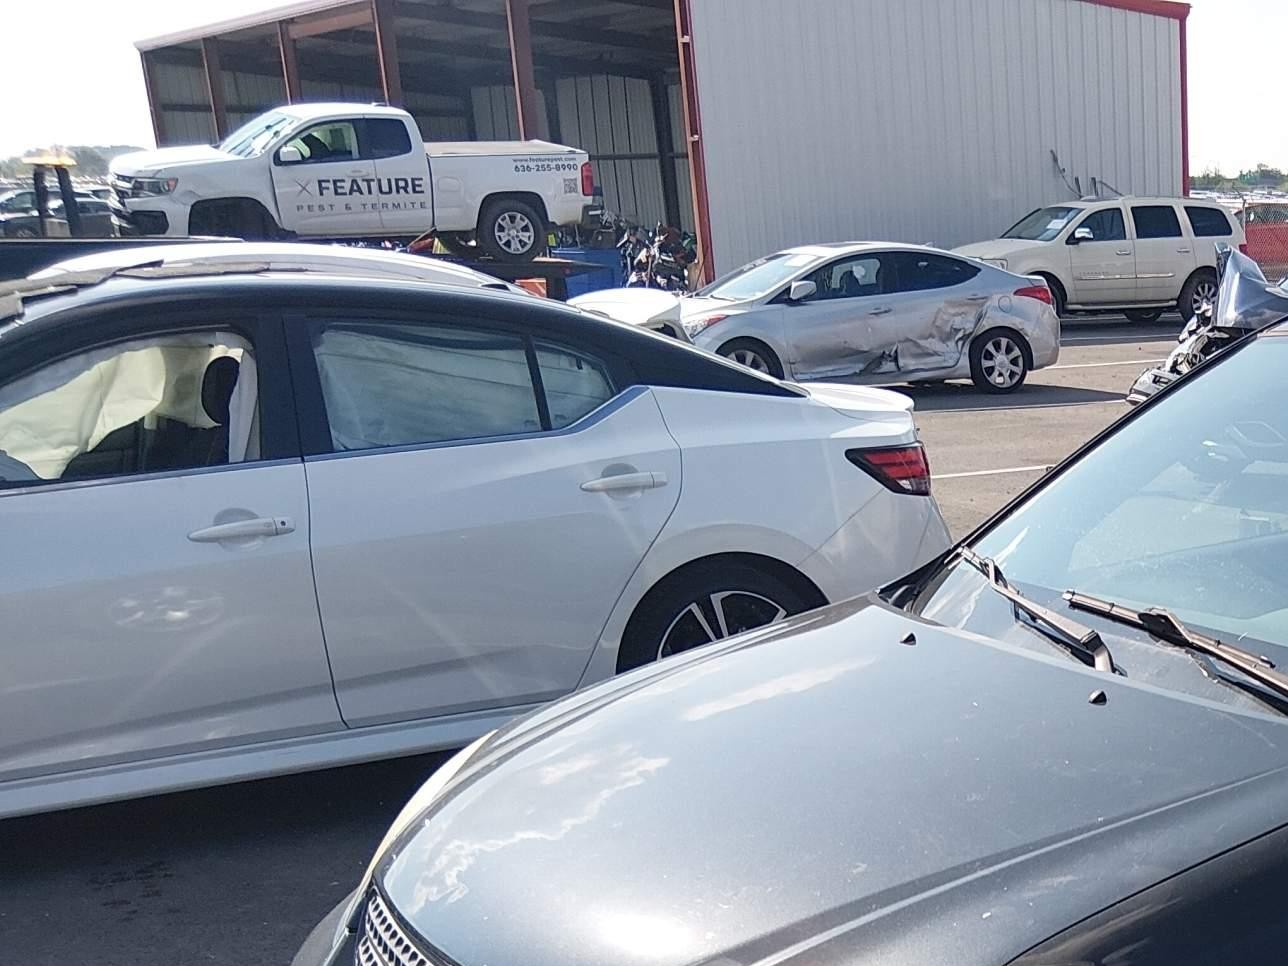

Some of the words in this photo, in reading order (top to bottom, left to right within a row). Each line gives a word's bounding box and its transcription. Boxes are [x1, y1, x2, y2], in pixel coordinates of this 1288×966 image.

[514, 164, 578, 172] 636-255-8990
[317, 177, 425, 196] FEATURE
[296, 203, 335, 212] PEST
[345, 203, 352, 211] &
[361, 202, 427, 210] TERMITE
